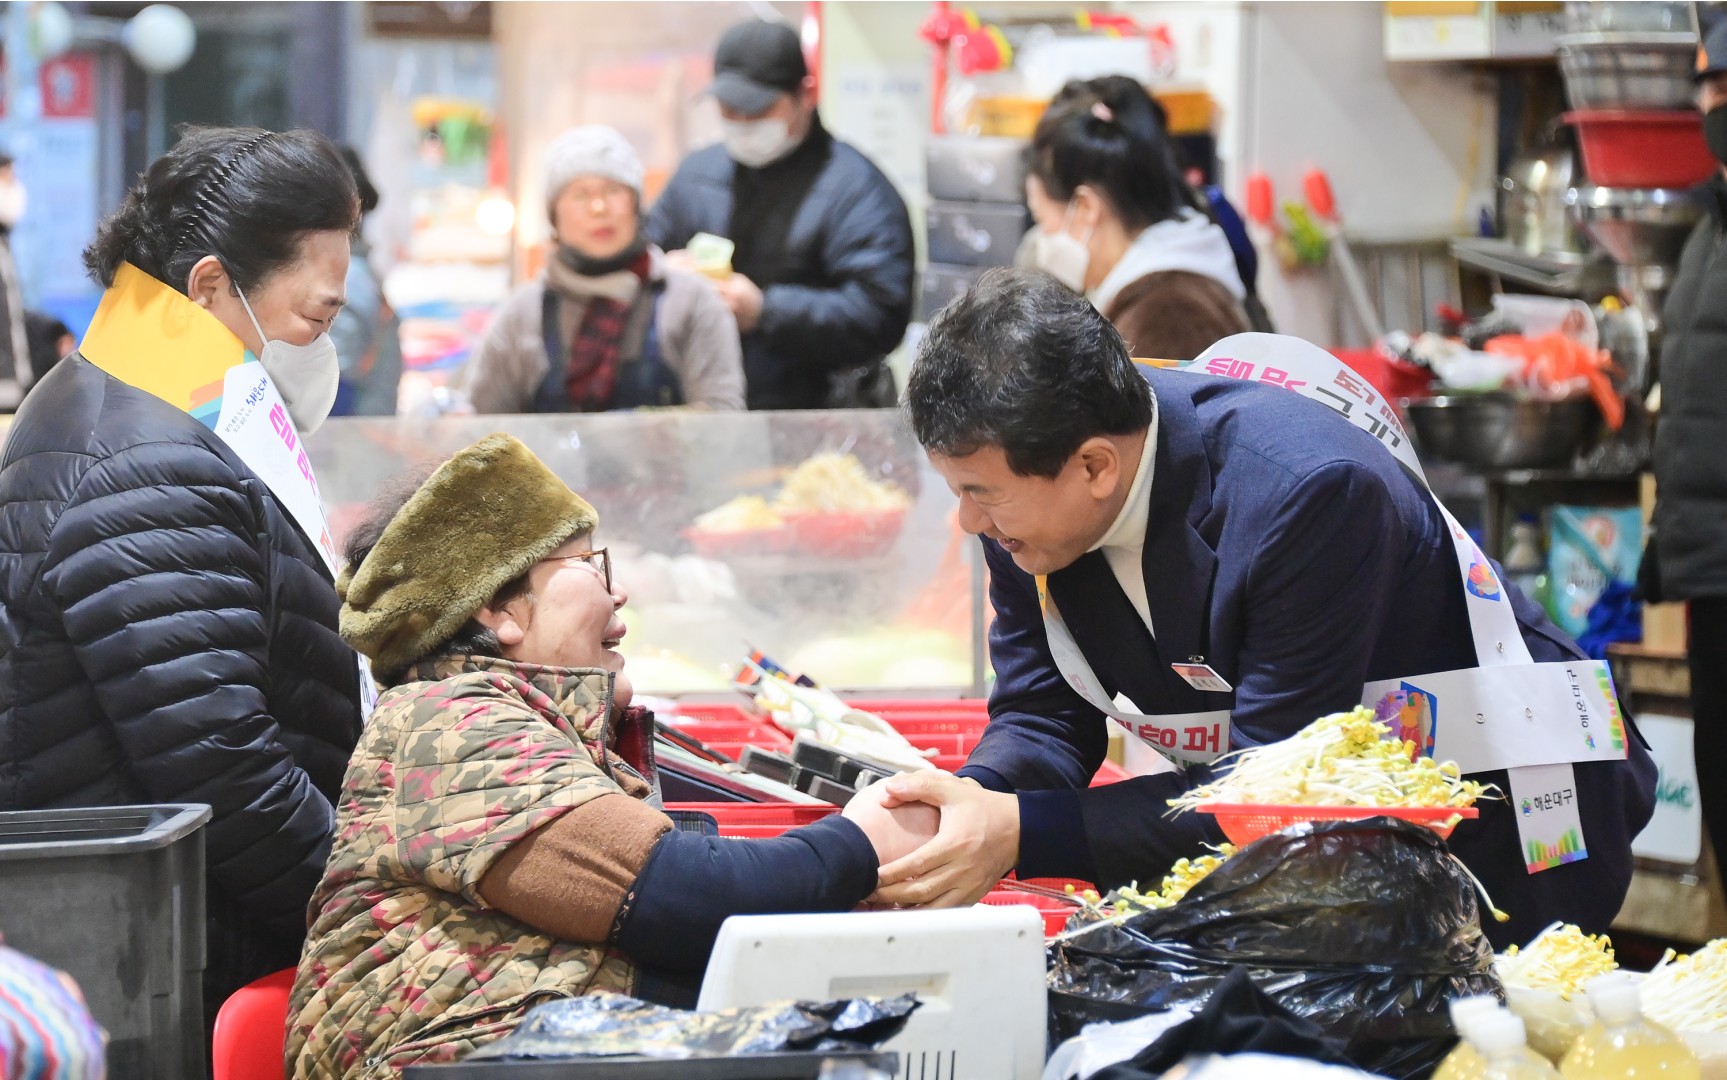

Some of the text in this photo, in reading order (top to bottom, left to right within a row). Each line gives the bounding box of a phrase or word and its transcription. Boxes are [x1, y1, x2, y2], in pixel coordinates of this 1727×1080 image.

[1566, 669, 1589, 728] 해운대구
[1138, 722, 1220, 753] 장보
[1533, 788, 1573, 811] 해운대구
